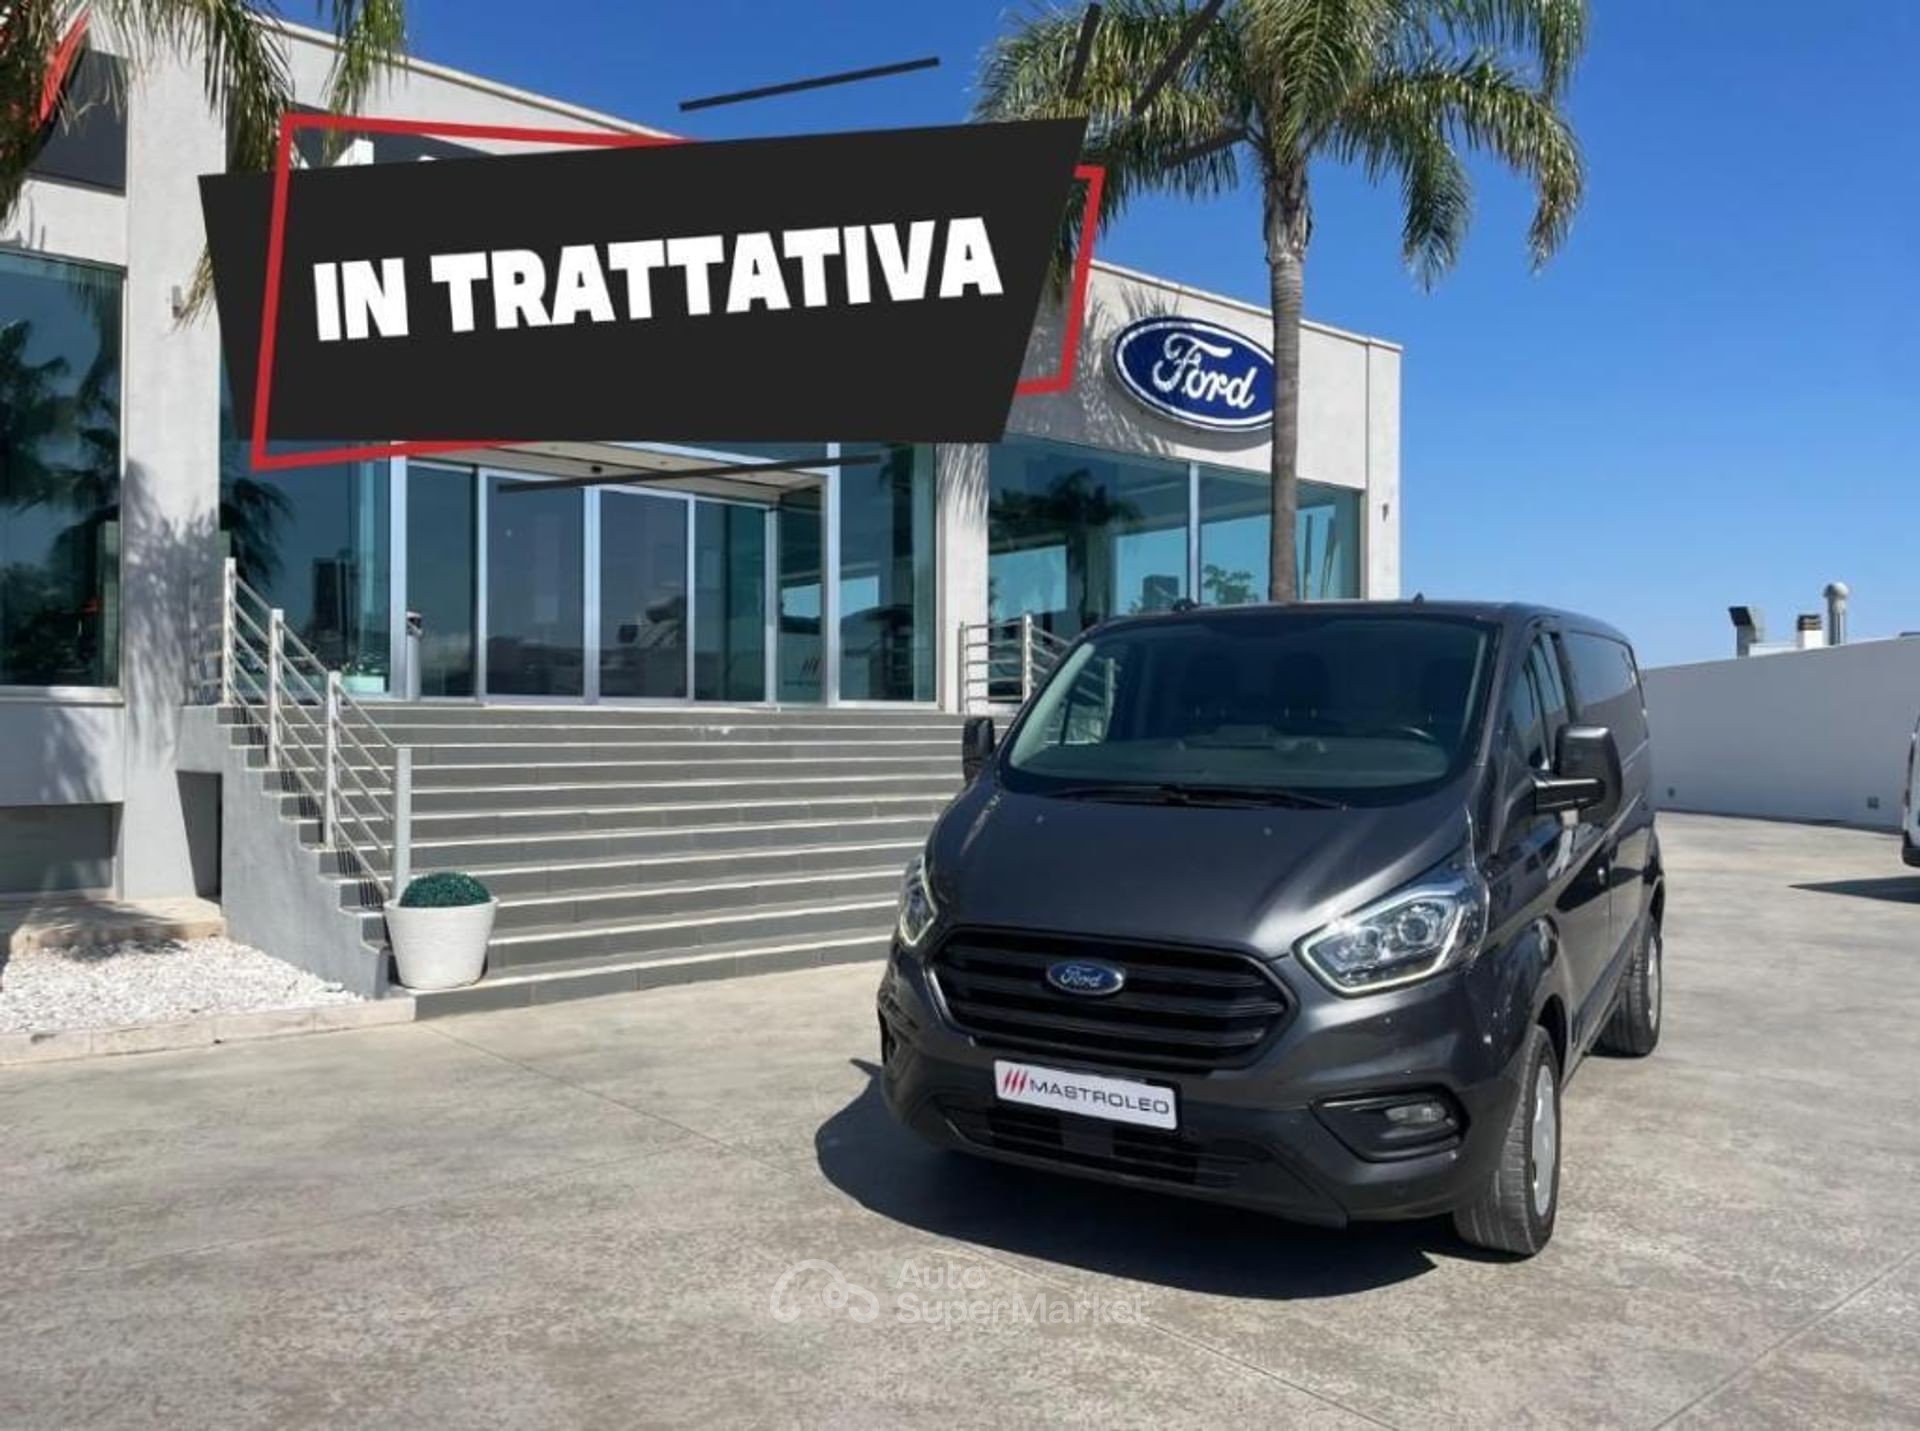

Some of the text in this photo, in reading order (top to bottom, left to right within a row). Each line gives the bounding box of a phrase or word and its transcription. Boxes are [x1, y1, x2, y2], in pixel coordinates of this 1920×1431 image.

[1152, 332, 1258, 410] Ford
[1058, 964, 1104, 988] Ford
[1029, 1077, 1170, 1116] MASTROLEO
